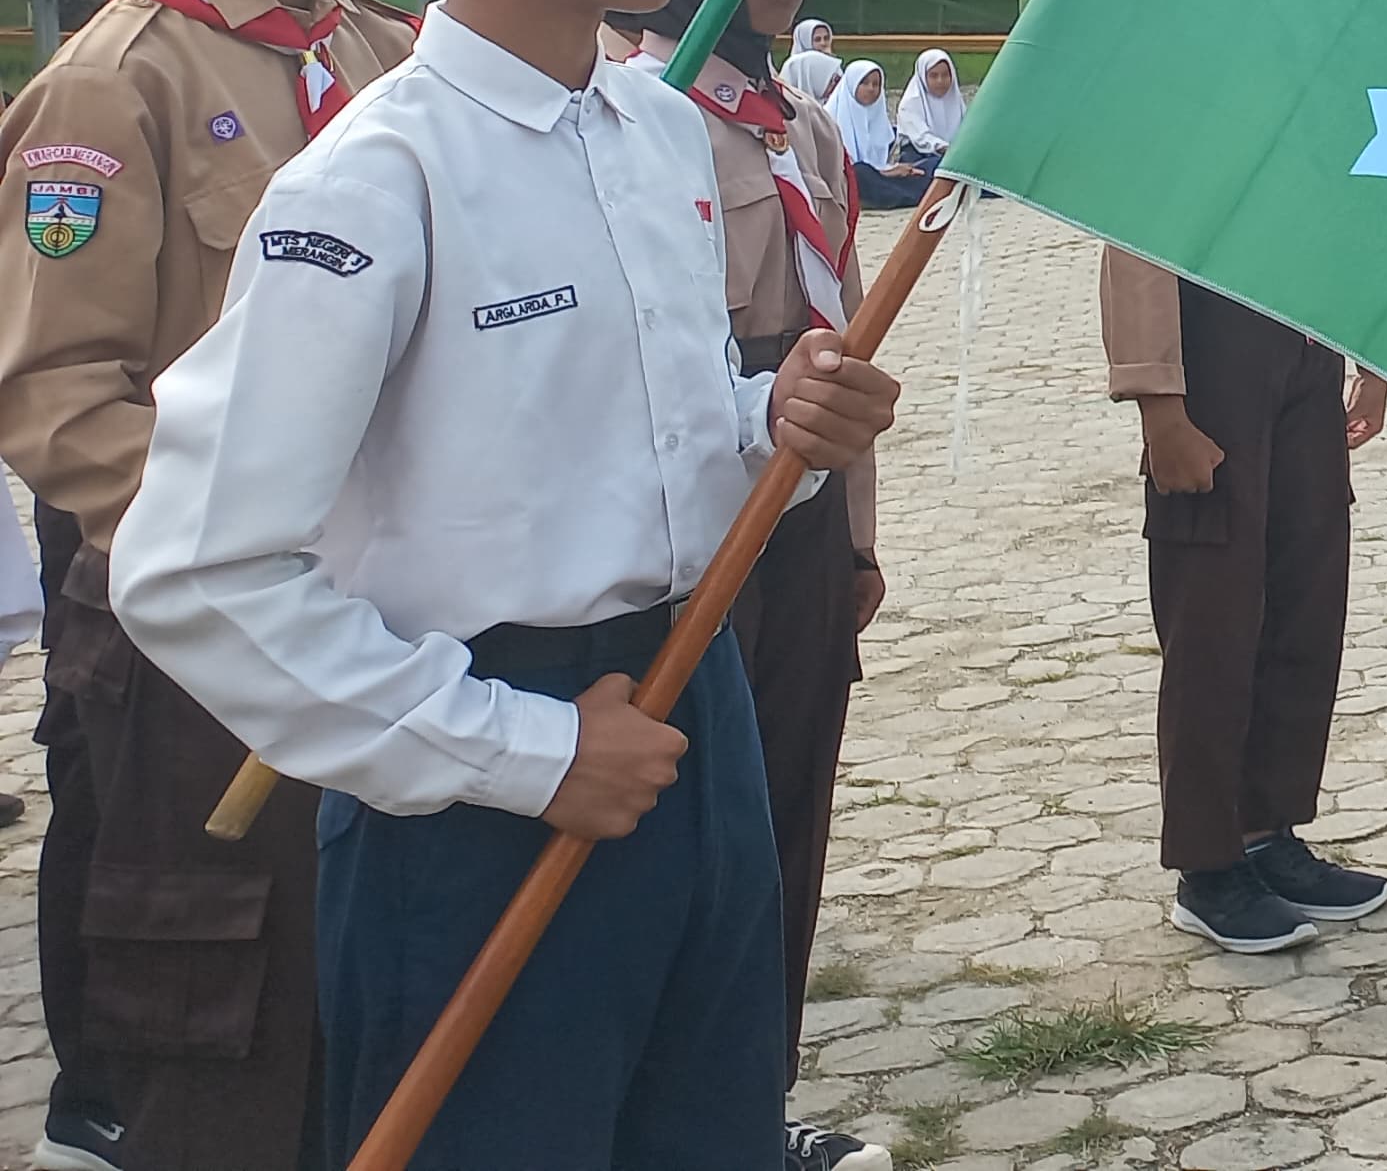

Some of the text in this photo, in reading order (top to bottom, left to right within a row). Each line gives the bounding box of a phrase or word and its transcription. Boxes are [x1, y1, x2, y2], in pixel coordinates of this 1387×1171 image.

[32, 184, 98, 196] JAMBI
[281, 246, 347, 270] MERANGIN
[304, 236, 353, 260] NEGERI
[517, 296, 553, 317] ARDA
